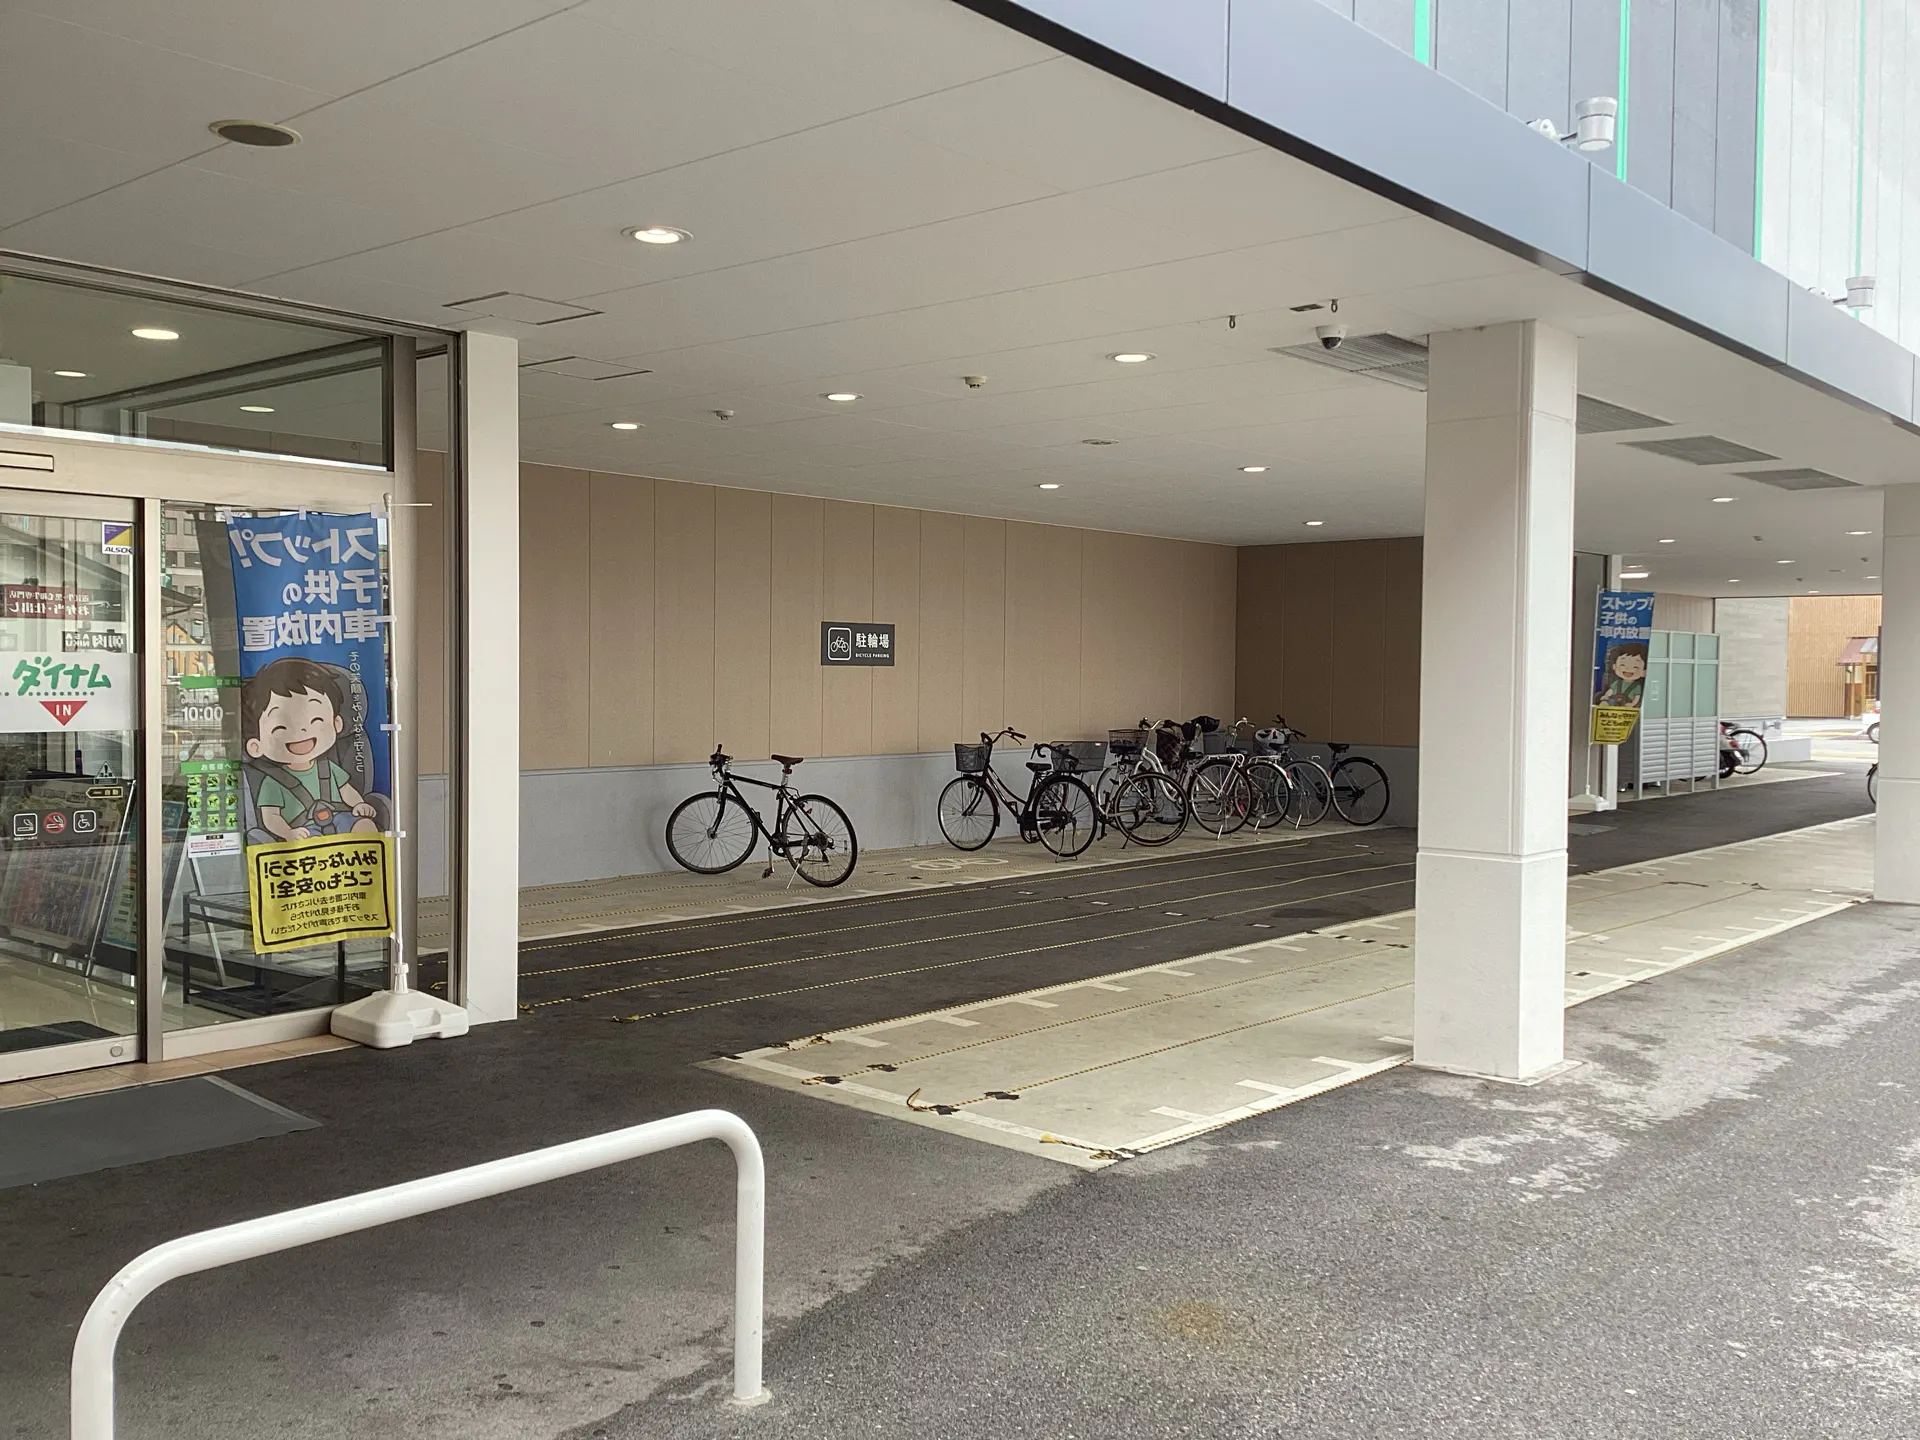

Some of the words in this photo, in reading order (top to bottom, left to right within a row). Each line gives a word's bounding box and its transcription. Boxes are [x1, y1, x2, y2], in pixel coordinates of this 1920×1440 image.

[1602, 597, 1655, 610] ストップ!
[1601, 612, 1637, 625] 子供の
[856, 633, 889, 648] 駐輪場
[12, 656, 112, 696] ダイナム
[55, 704, 72, 716] IN
[181, 706, 224, 721] 10:00
